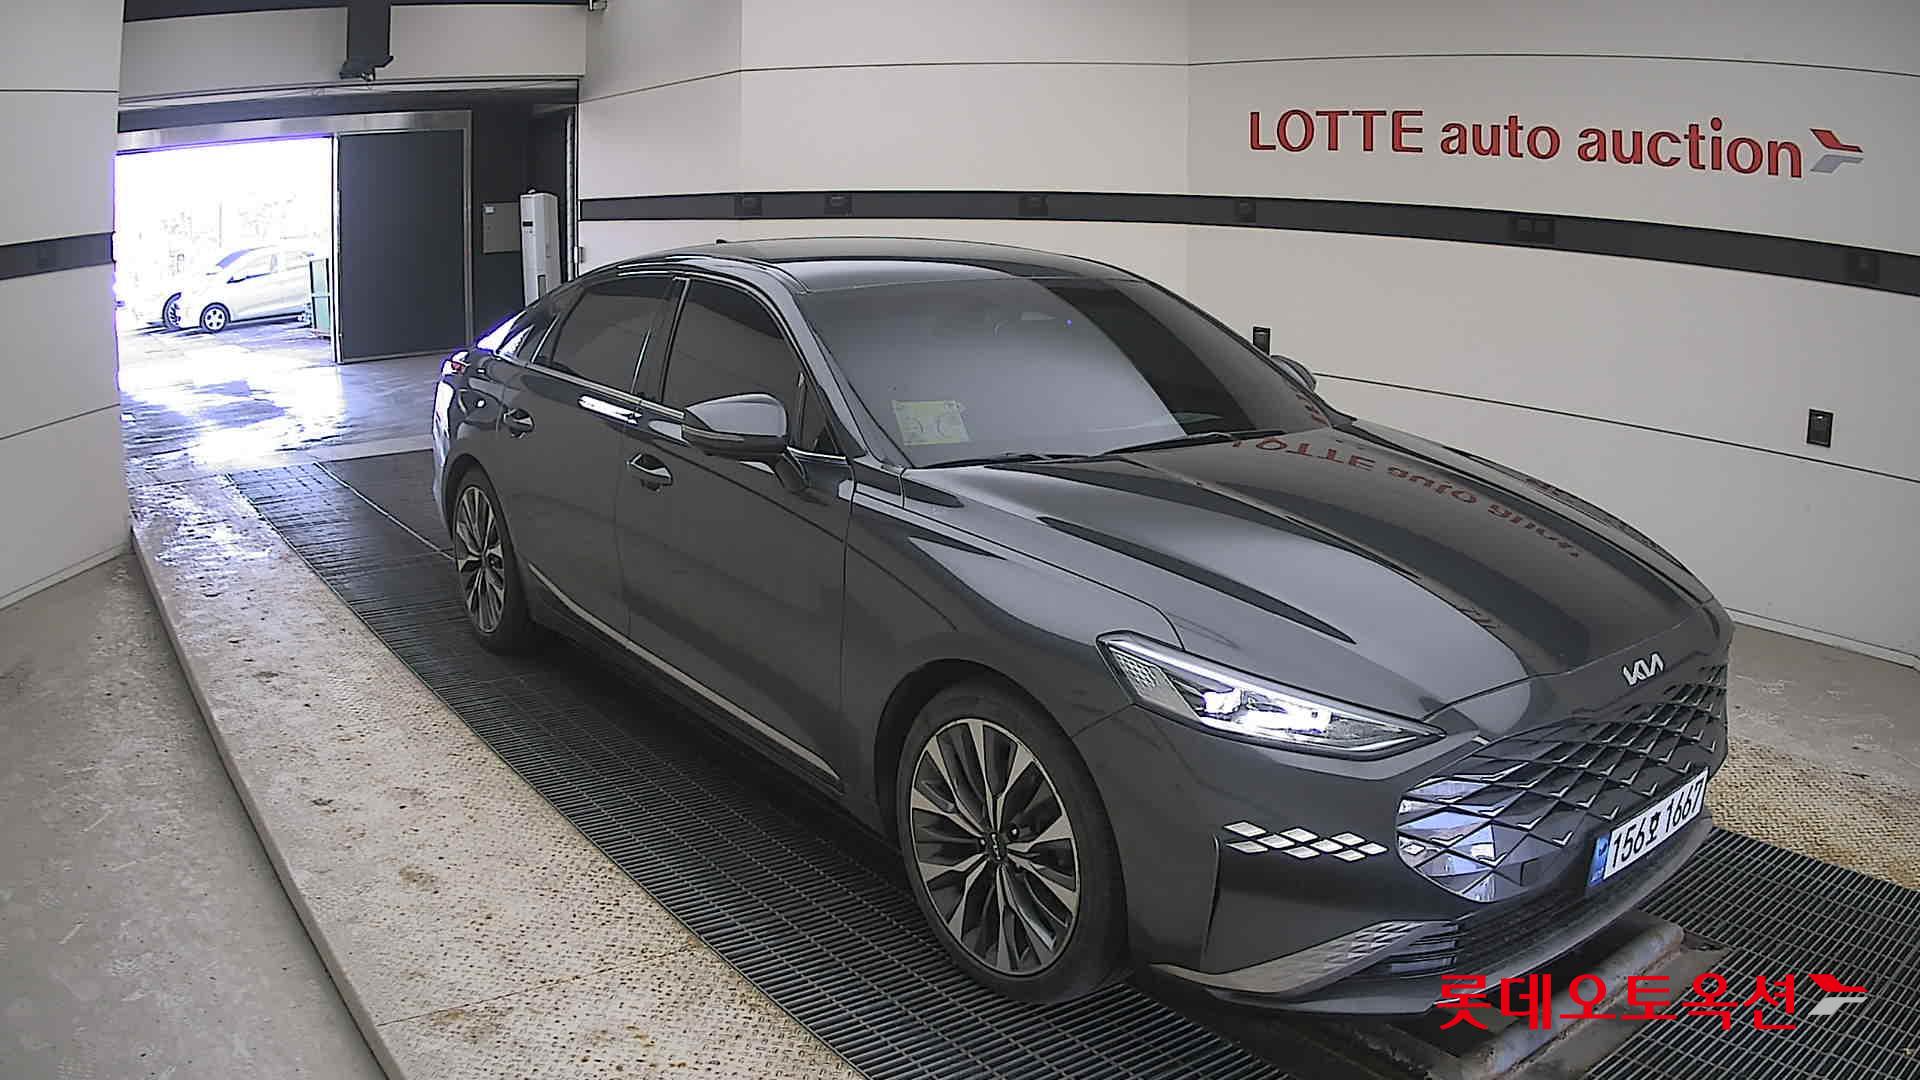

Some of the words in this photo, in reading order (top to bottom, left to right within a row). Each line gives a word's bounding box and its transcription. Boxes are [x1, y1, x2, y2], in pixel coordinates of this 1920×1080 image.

[1249, 110, 1424, 153] LOTTE
[1440, 116, 1561, 160] auto
[1576, 117, 1803, 178] auction
[1622, 652, 1665, 687] KIA
[1665, 777, 1705, 833] 1667
